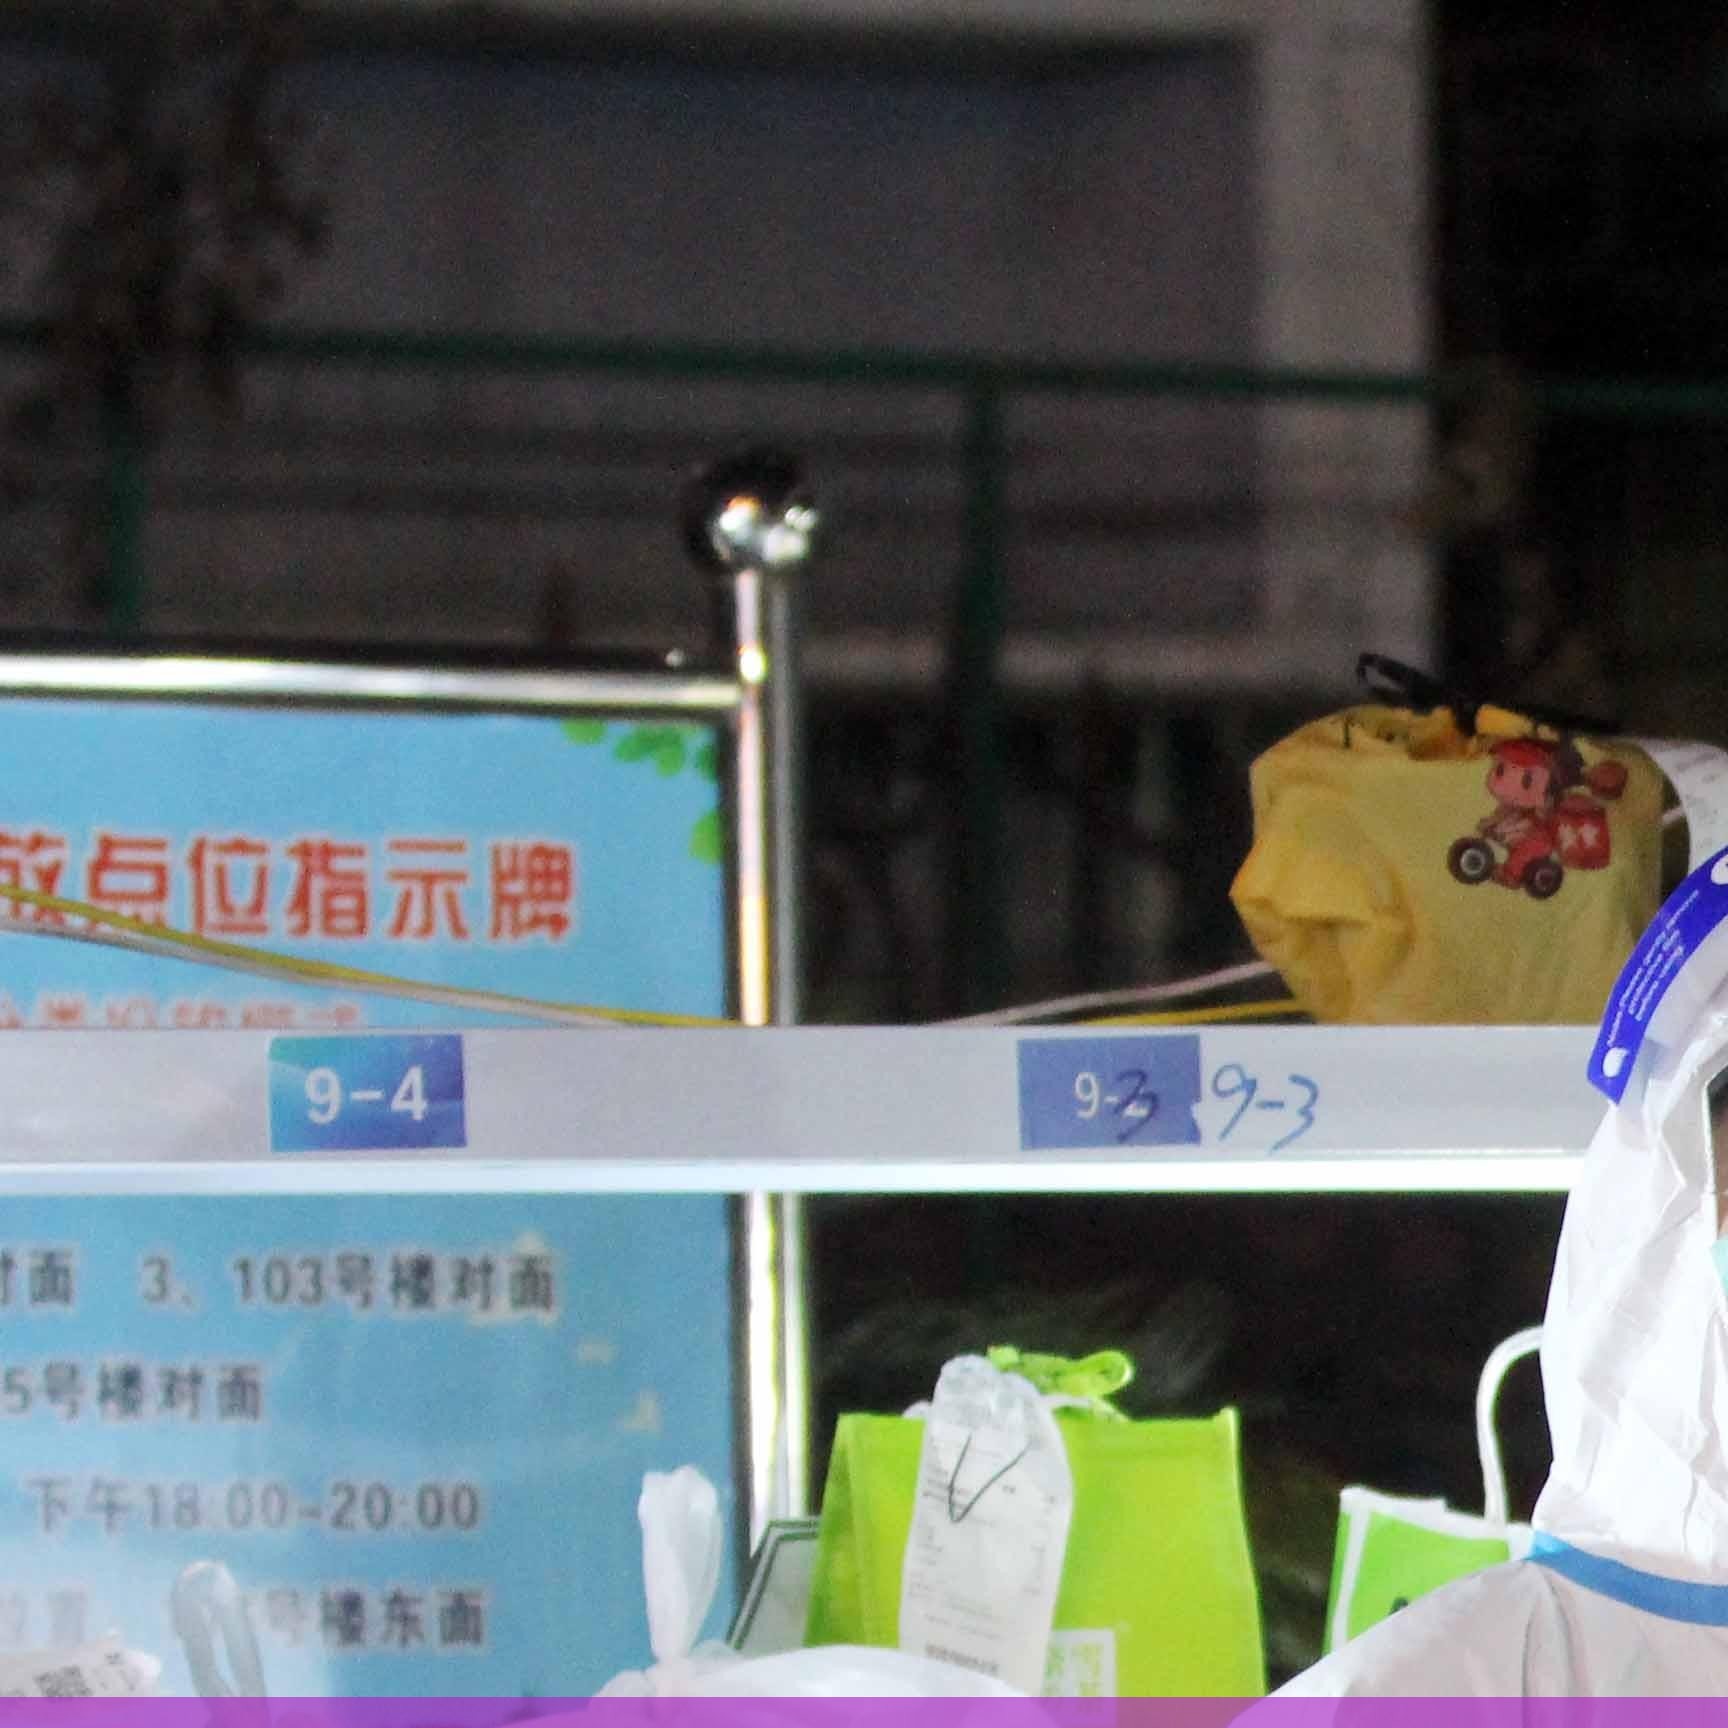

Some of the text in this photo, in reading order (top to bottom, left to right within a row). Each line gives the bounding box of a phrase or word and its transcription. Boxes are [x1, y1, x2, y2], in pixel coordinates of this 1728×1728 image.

[303, 1066, 429, 1125] 9-4
[1210, 1062, 1320, 1156] 9-3
[28, 1478, 481, 1531] 下午18:00-20:00
